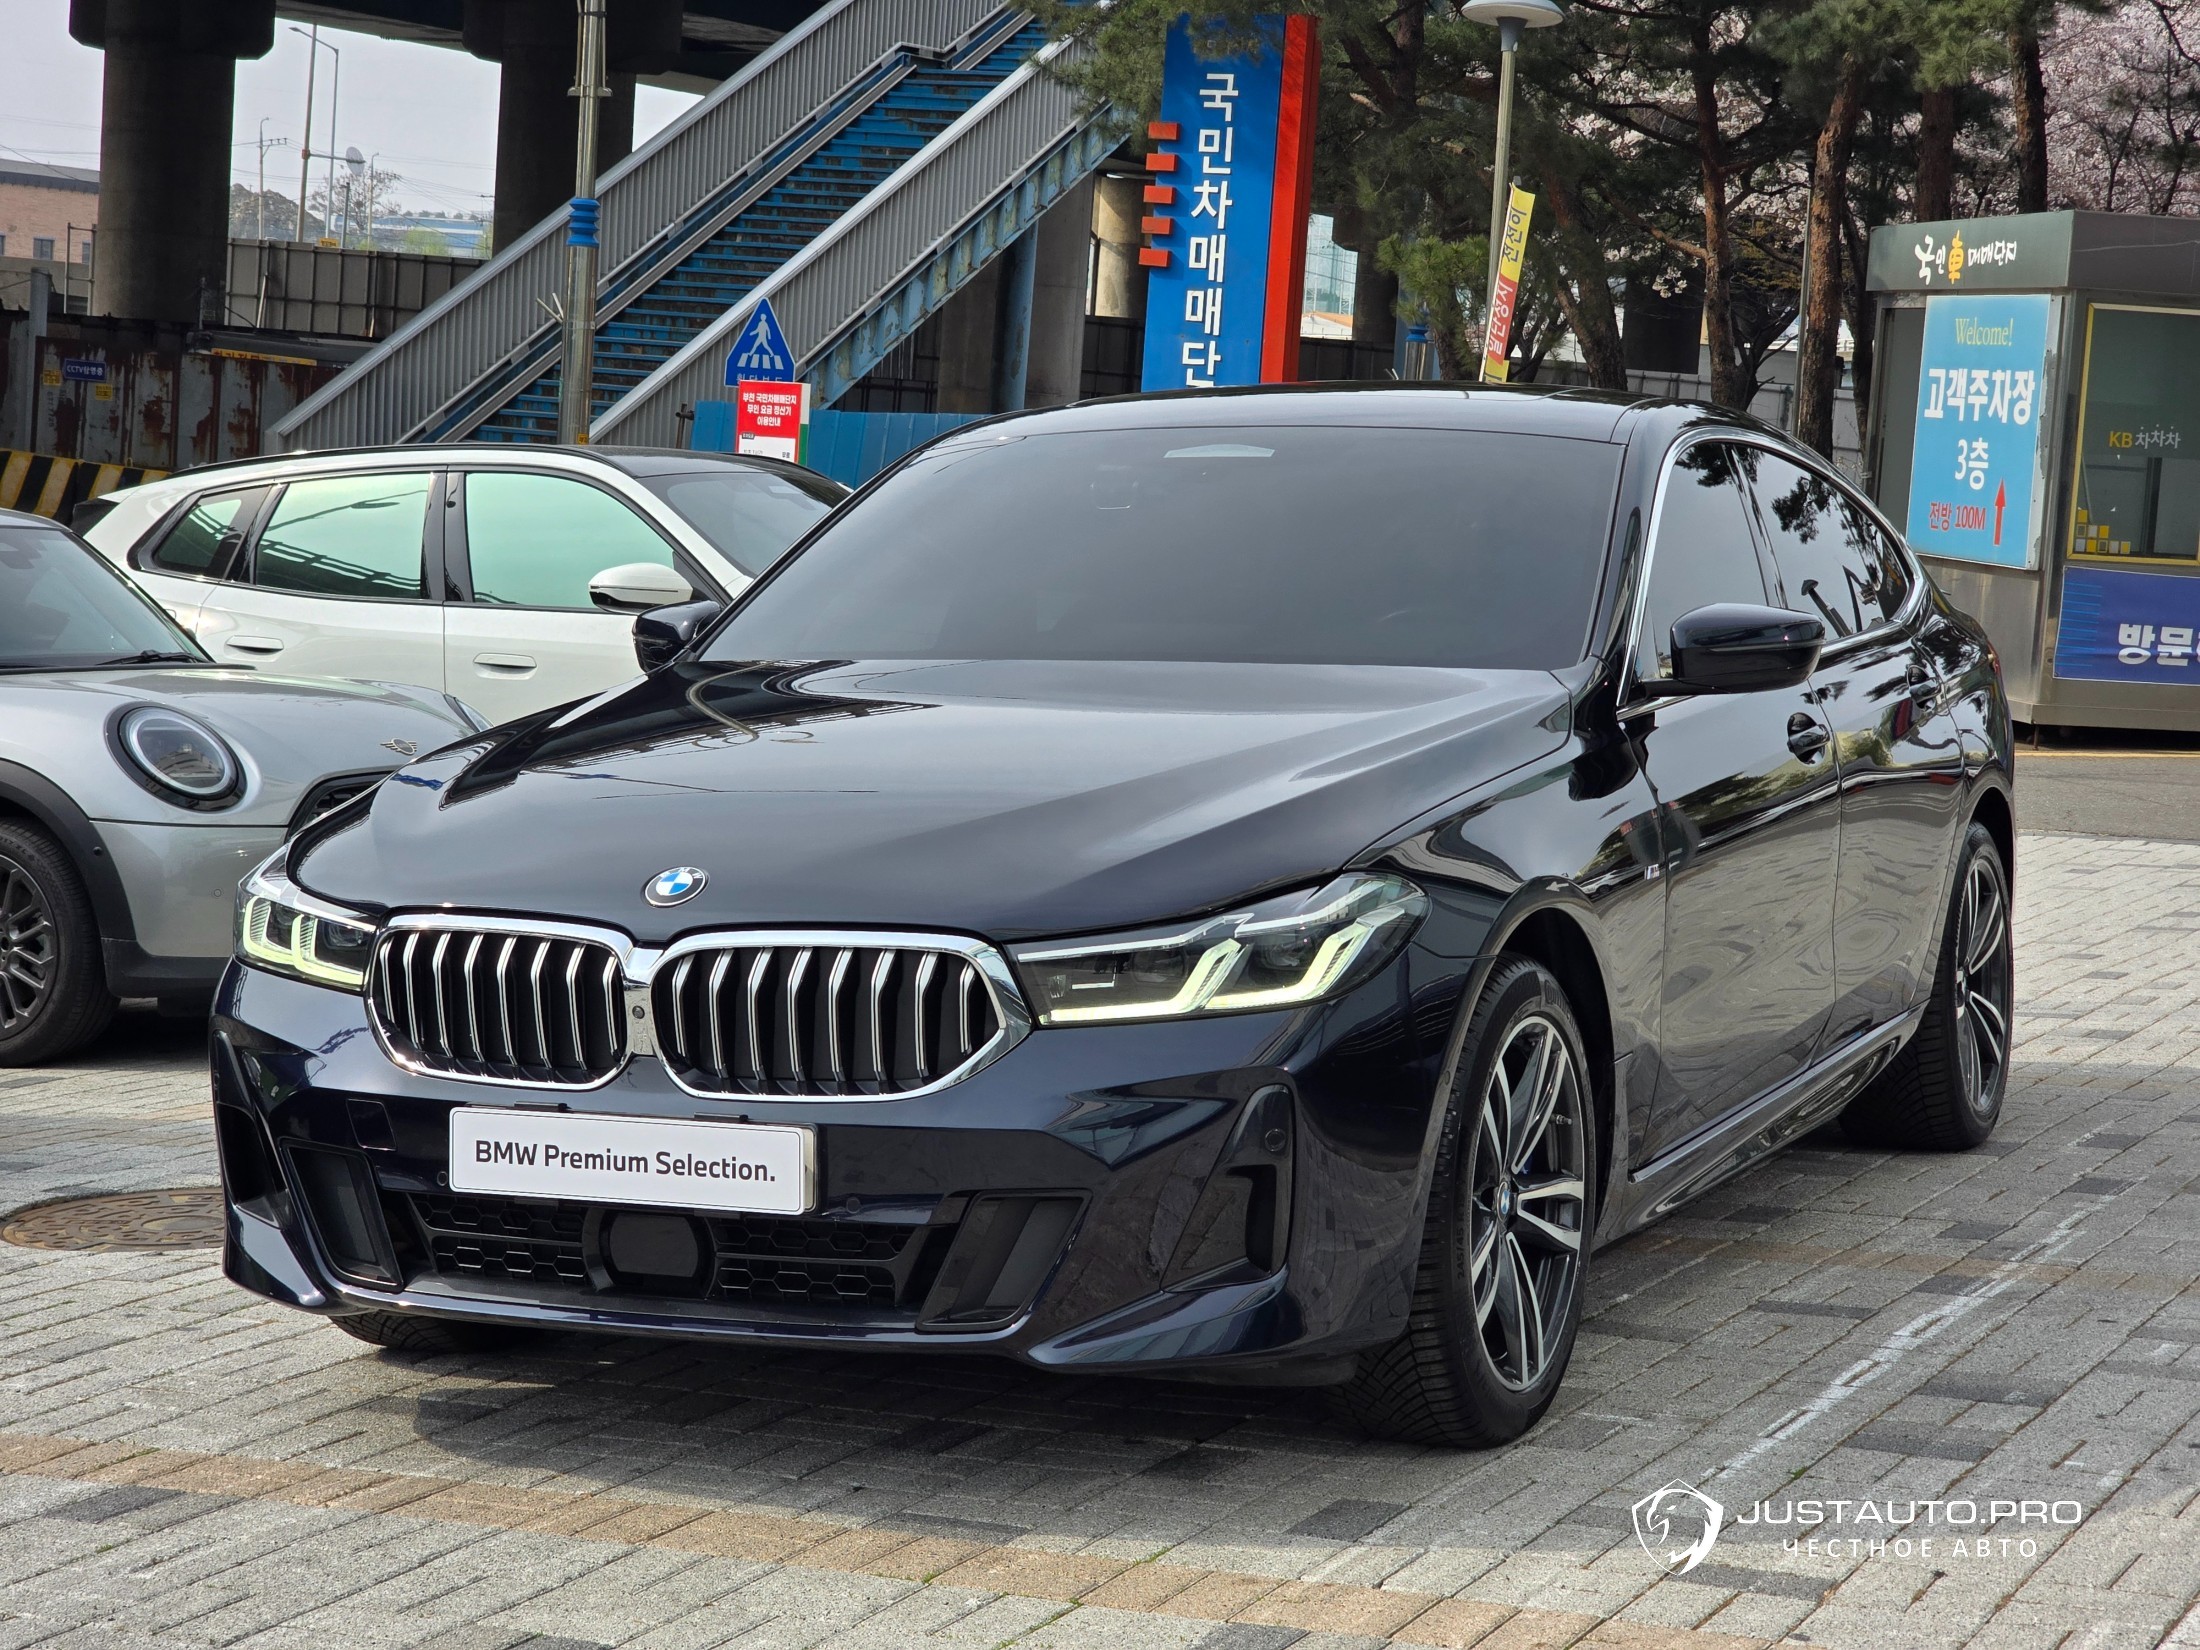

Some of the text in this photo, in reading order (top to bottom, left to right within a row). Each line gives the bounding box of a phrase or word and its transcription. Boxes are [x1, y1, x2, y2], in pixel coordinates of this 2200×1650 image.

[1955, 317, 2014, 346] Welcome!
[747, 404, 792, 416] 무인 요금 정산기
[1924, 368, 2035, 425] 고객주차장
[757, 416, 781, 427] 이용안내
[1955, 437, 1989, 490] 3층
[1929, 502, 1986, 531] 전방 100M
[2118, 624, 2200, 667] 방문
[475, 1140, 776, 1182] BMW Premium Selection.
